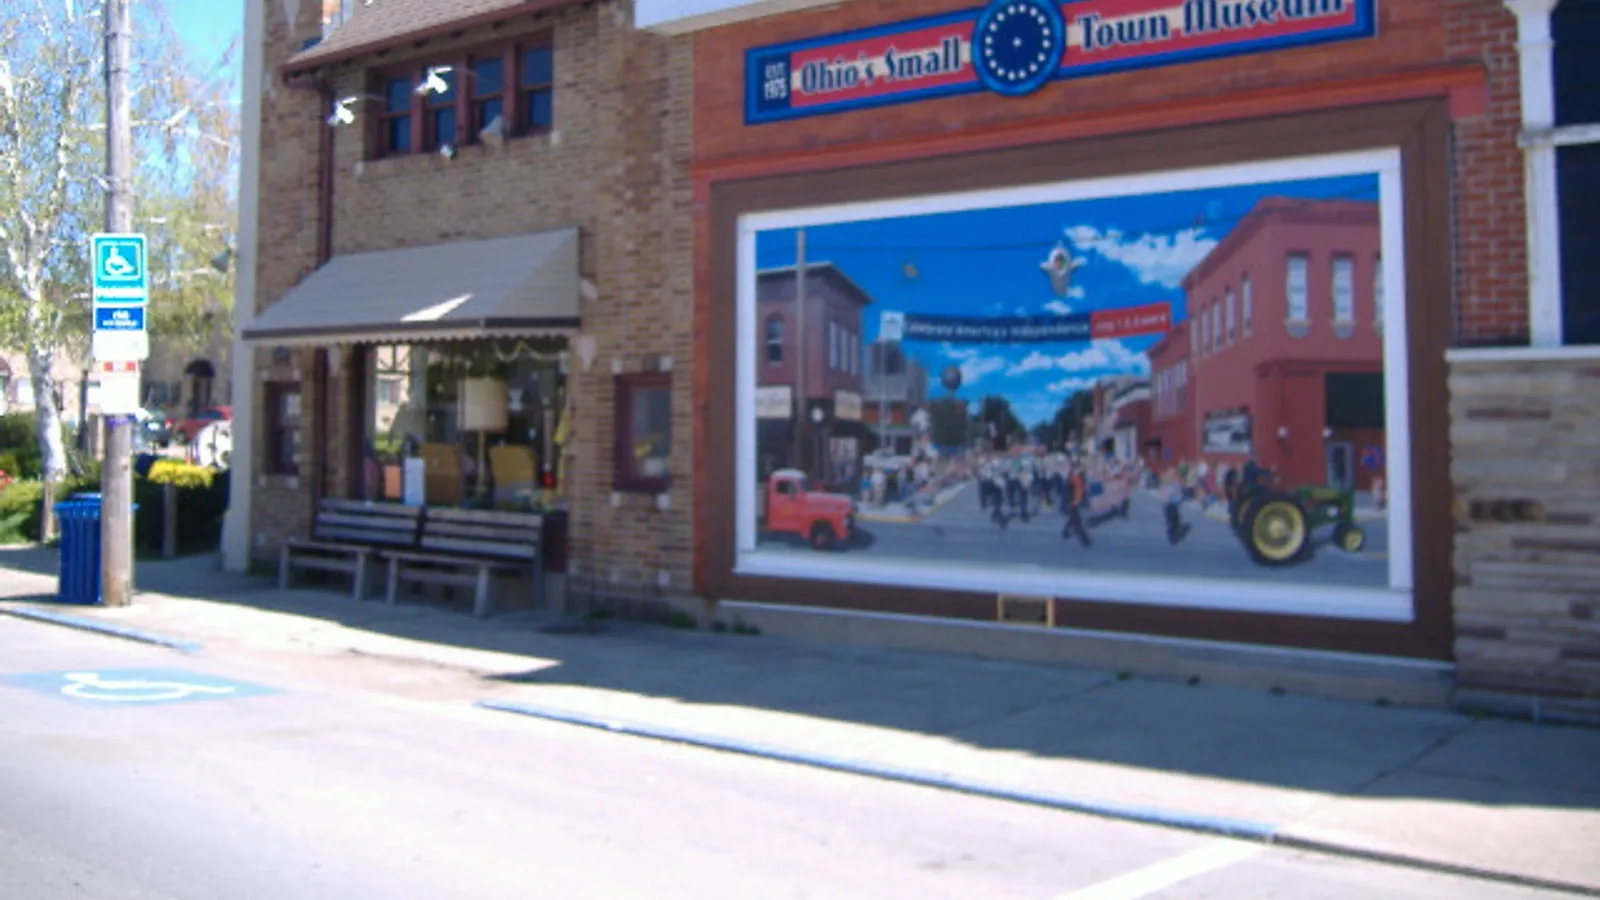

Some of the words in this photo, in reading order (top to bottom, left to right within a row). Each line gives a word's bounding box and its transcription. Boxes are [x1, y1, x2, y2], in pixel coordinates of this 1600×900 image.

[801, 54, 876, 95] Ohio's
[883, 35, 962, 81] Small
[1078, 14, 1170, 50] Town
